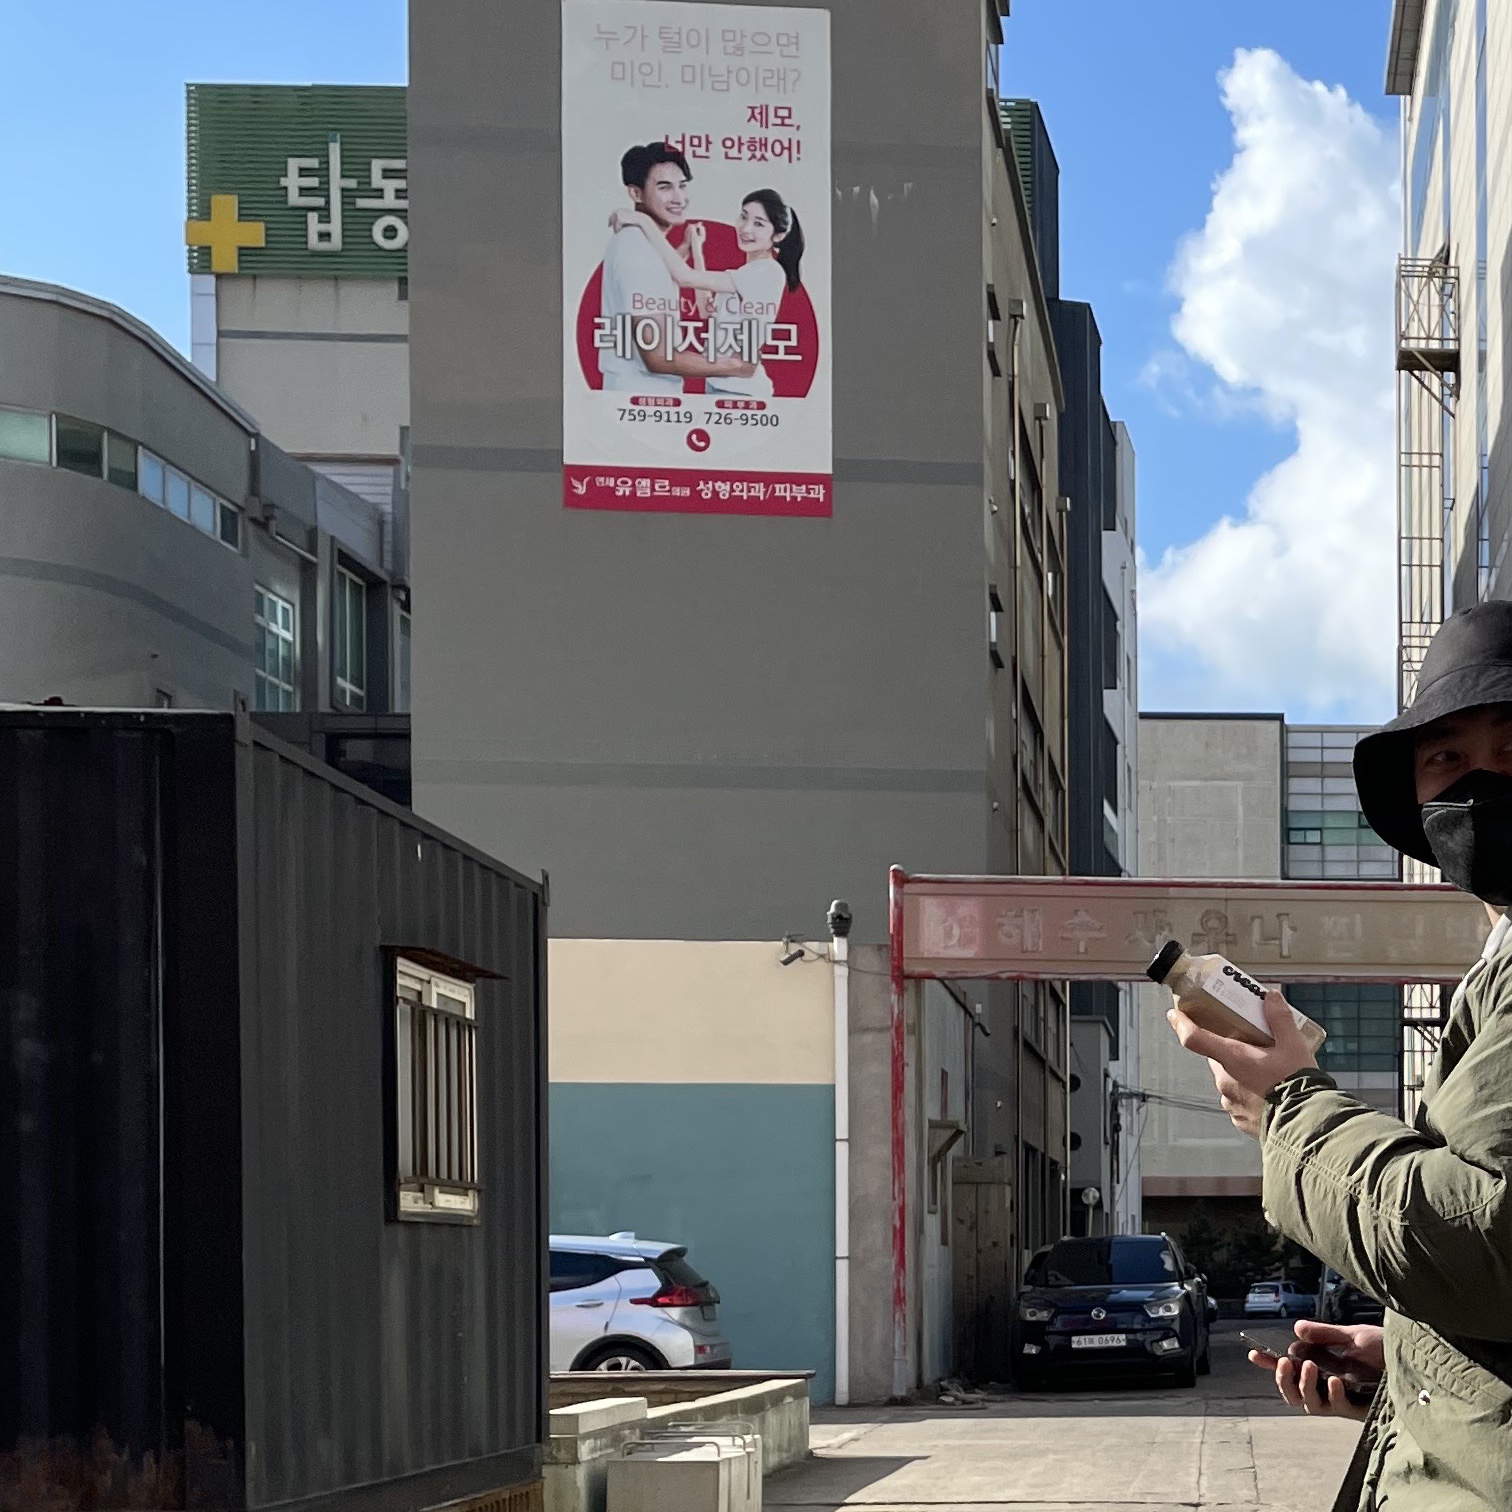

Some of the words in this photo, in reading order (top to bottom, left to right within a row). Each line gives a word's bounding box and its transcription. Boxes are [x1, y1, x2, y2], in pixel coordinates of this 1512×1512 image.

[594, 24, 647, 52] 누가
[658, 26, 710, 54] 털이
[721, 29, 800, 59] 많으면
[680, 64, 801, 95] 미남이래?
[746, 104, 801, 131] 제모,
[664, 133, 713, 160] 너만
[721, 136, 801, 164] 안했어!
[632, 293, 699, 316] Beauty
[705, 298, 719, 313] &
[725, 296, 777, 316] Clean
[593, 314, 803, 365] 레이저제모
[617, 408, 693, 424] 759-9119
[703, 411, 780, 427] 726-9500
